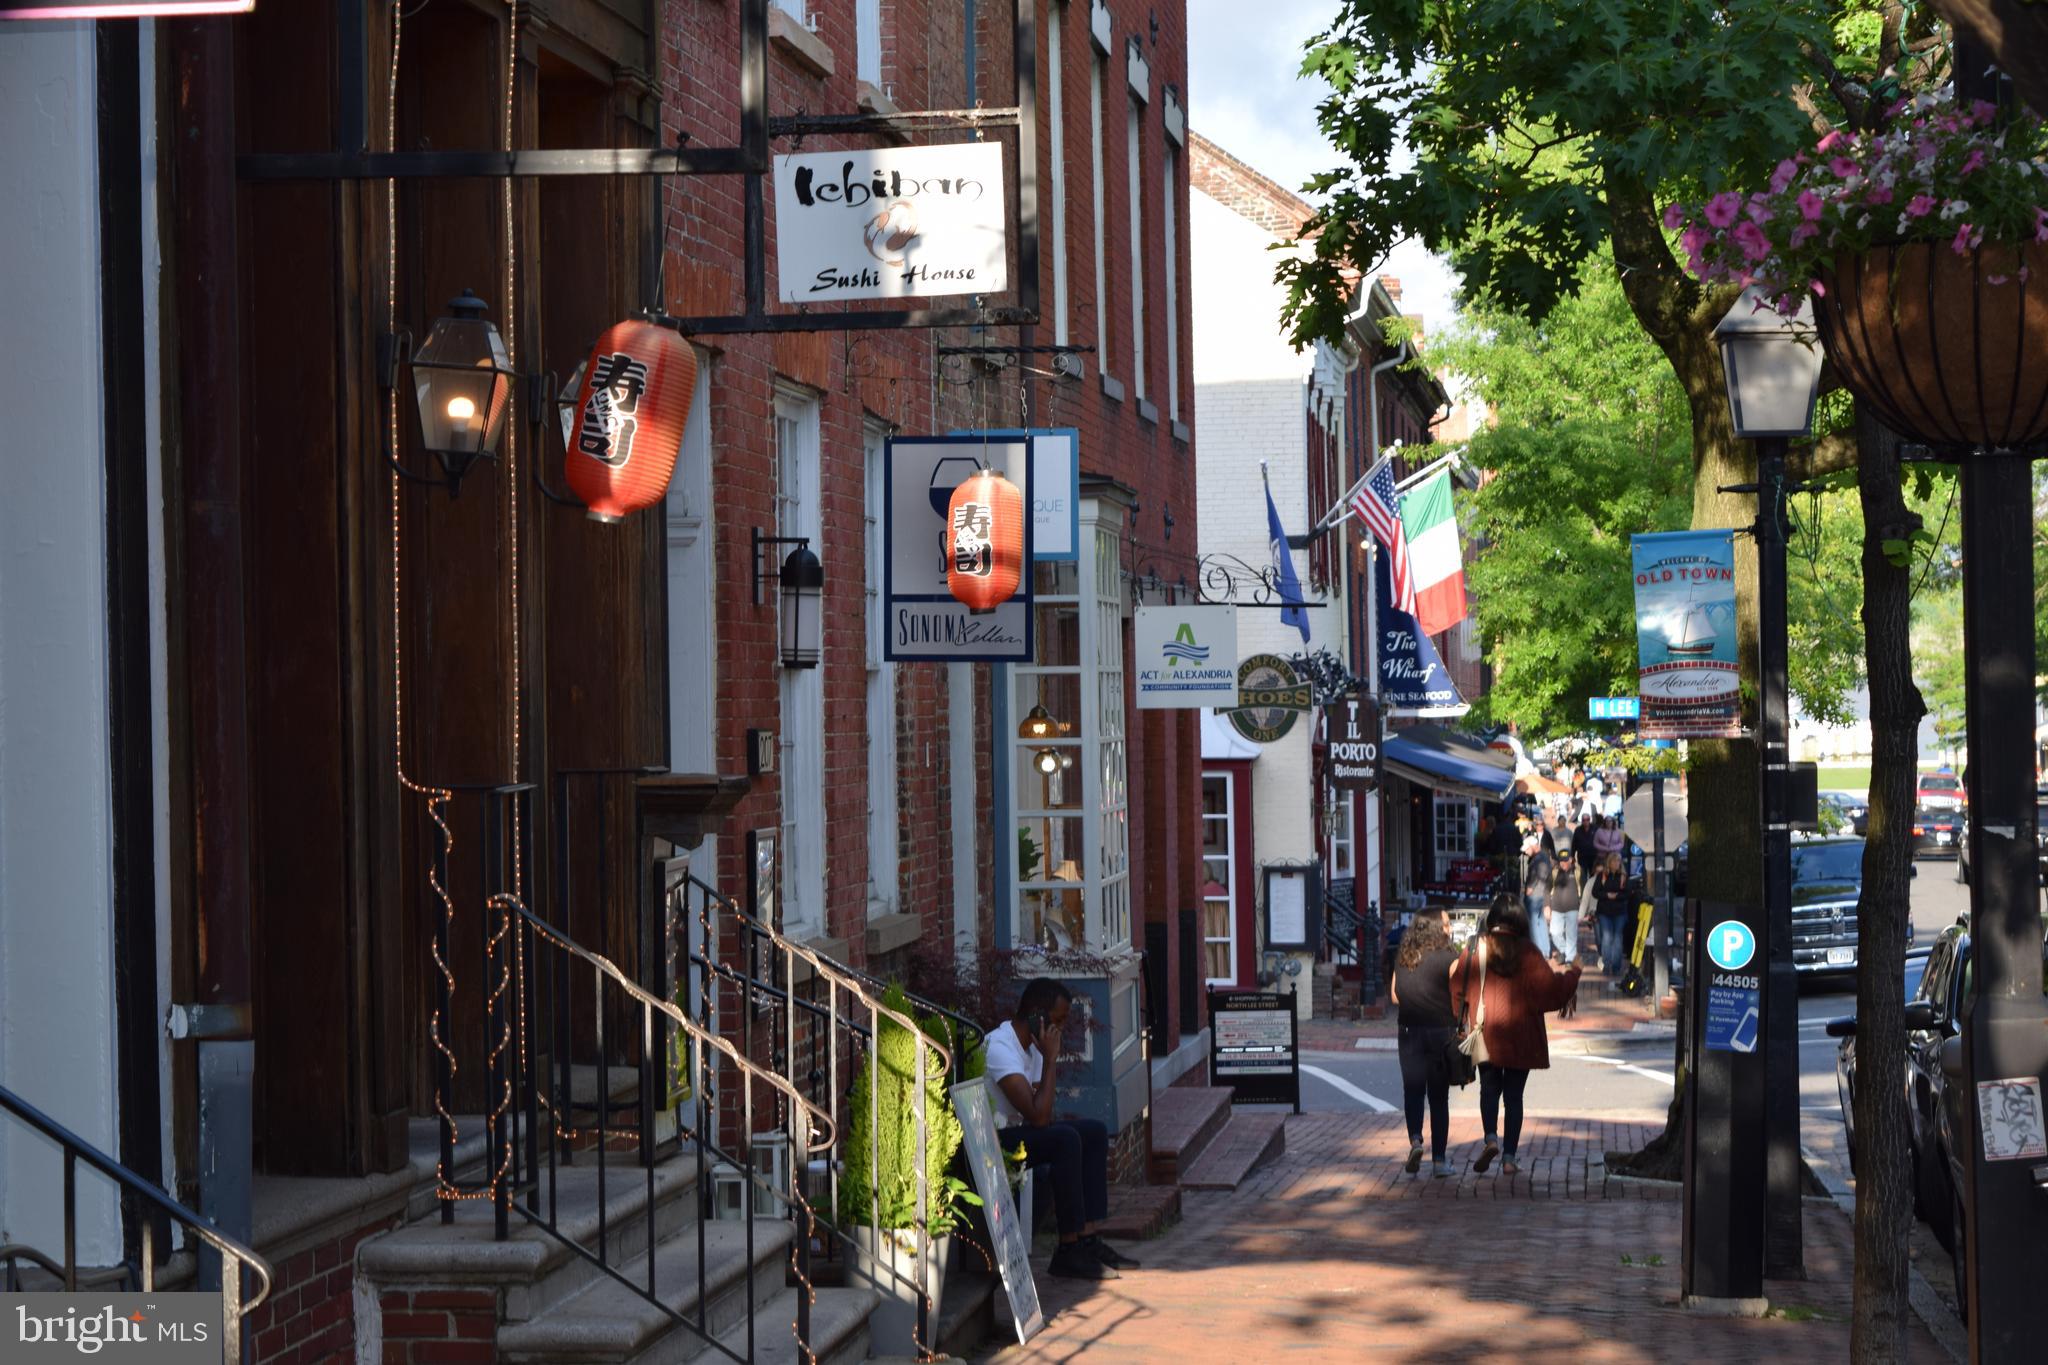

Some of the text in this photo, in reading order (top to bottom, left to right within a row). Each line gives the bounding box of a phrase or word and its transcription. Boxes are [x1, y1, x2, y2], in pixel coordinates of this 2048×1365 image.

[795, 161, 983, 207] Ichiban
[810, 264, 977, 292] Sushi House
[1636, 566, 1732, 585] OLD TOWN
[1386, 631, 1416, 651] The
[1141, 671, 1159, 680] ACT
[1173, 669, 1233, 680] ALEXANDRIA
[1238, 656, 1293, 679] COMFORT
[1382, 657, 1436, 683] Wharf
[1650, 672, 1723, 694] Alexandria
[1239, 689, 1311, 705] HOES
[1408, 690, 1452, 701] SEAFOOD
[1595, 700, 1633, 717] N LEE
[1655, 707, 1725, 717] VisitAlexandriaVA.com
[1253, 728, 1280, 740] ONE
[1347, 721, 1361, 740] IL
[1330, 742, 1377, 761] PORTO
[1334, 763, 1374, 778] Ristorante
[1723, 929, 1744, 962] P
